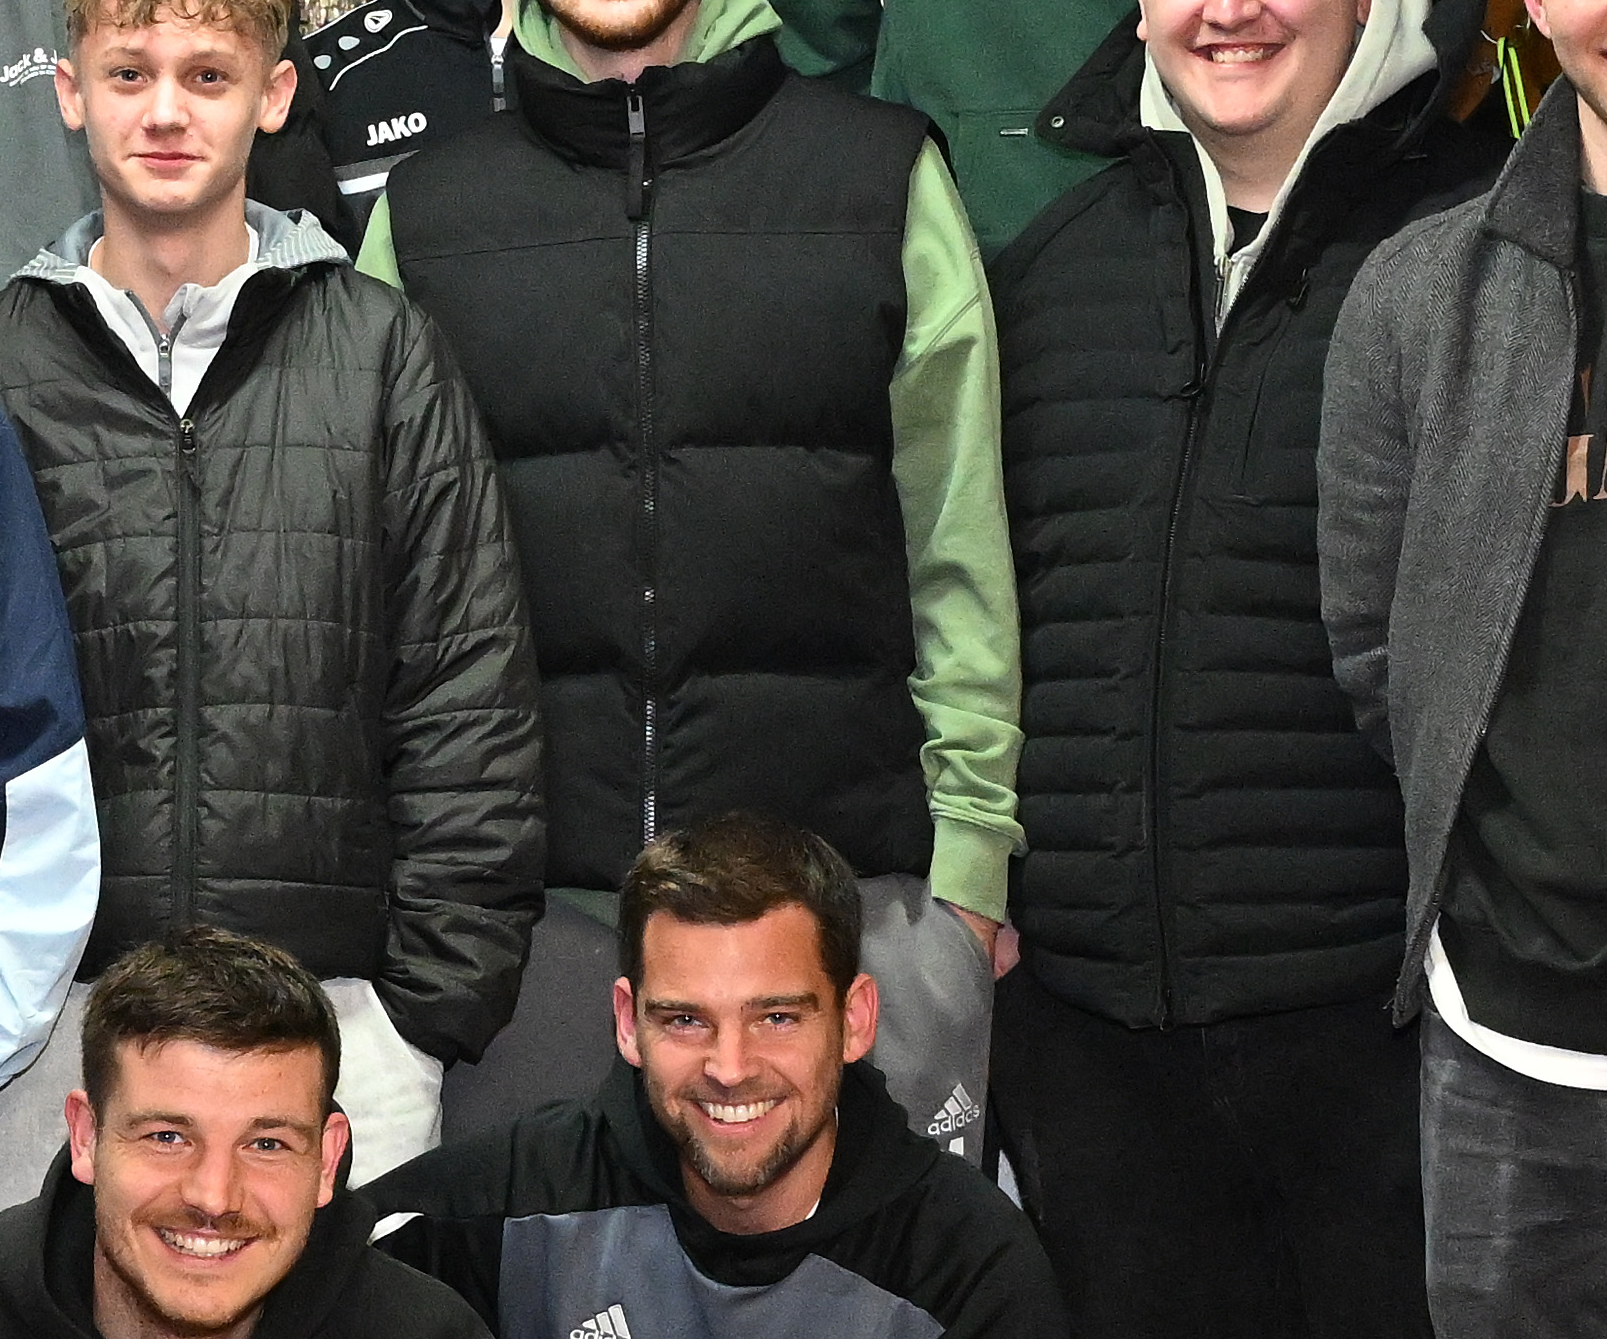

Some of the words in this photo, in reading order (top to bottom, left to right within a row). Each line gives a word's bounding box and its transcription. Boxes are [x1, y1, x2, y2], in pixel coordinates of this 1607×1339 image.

[0, 53, 32, 83] Jack
[33, 48, 49, 63] &
[366, 111, 428, 147] JAKO
